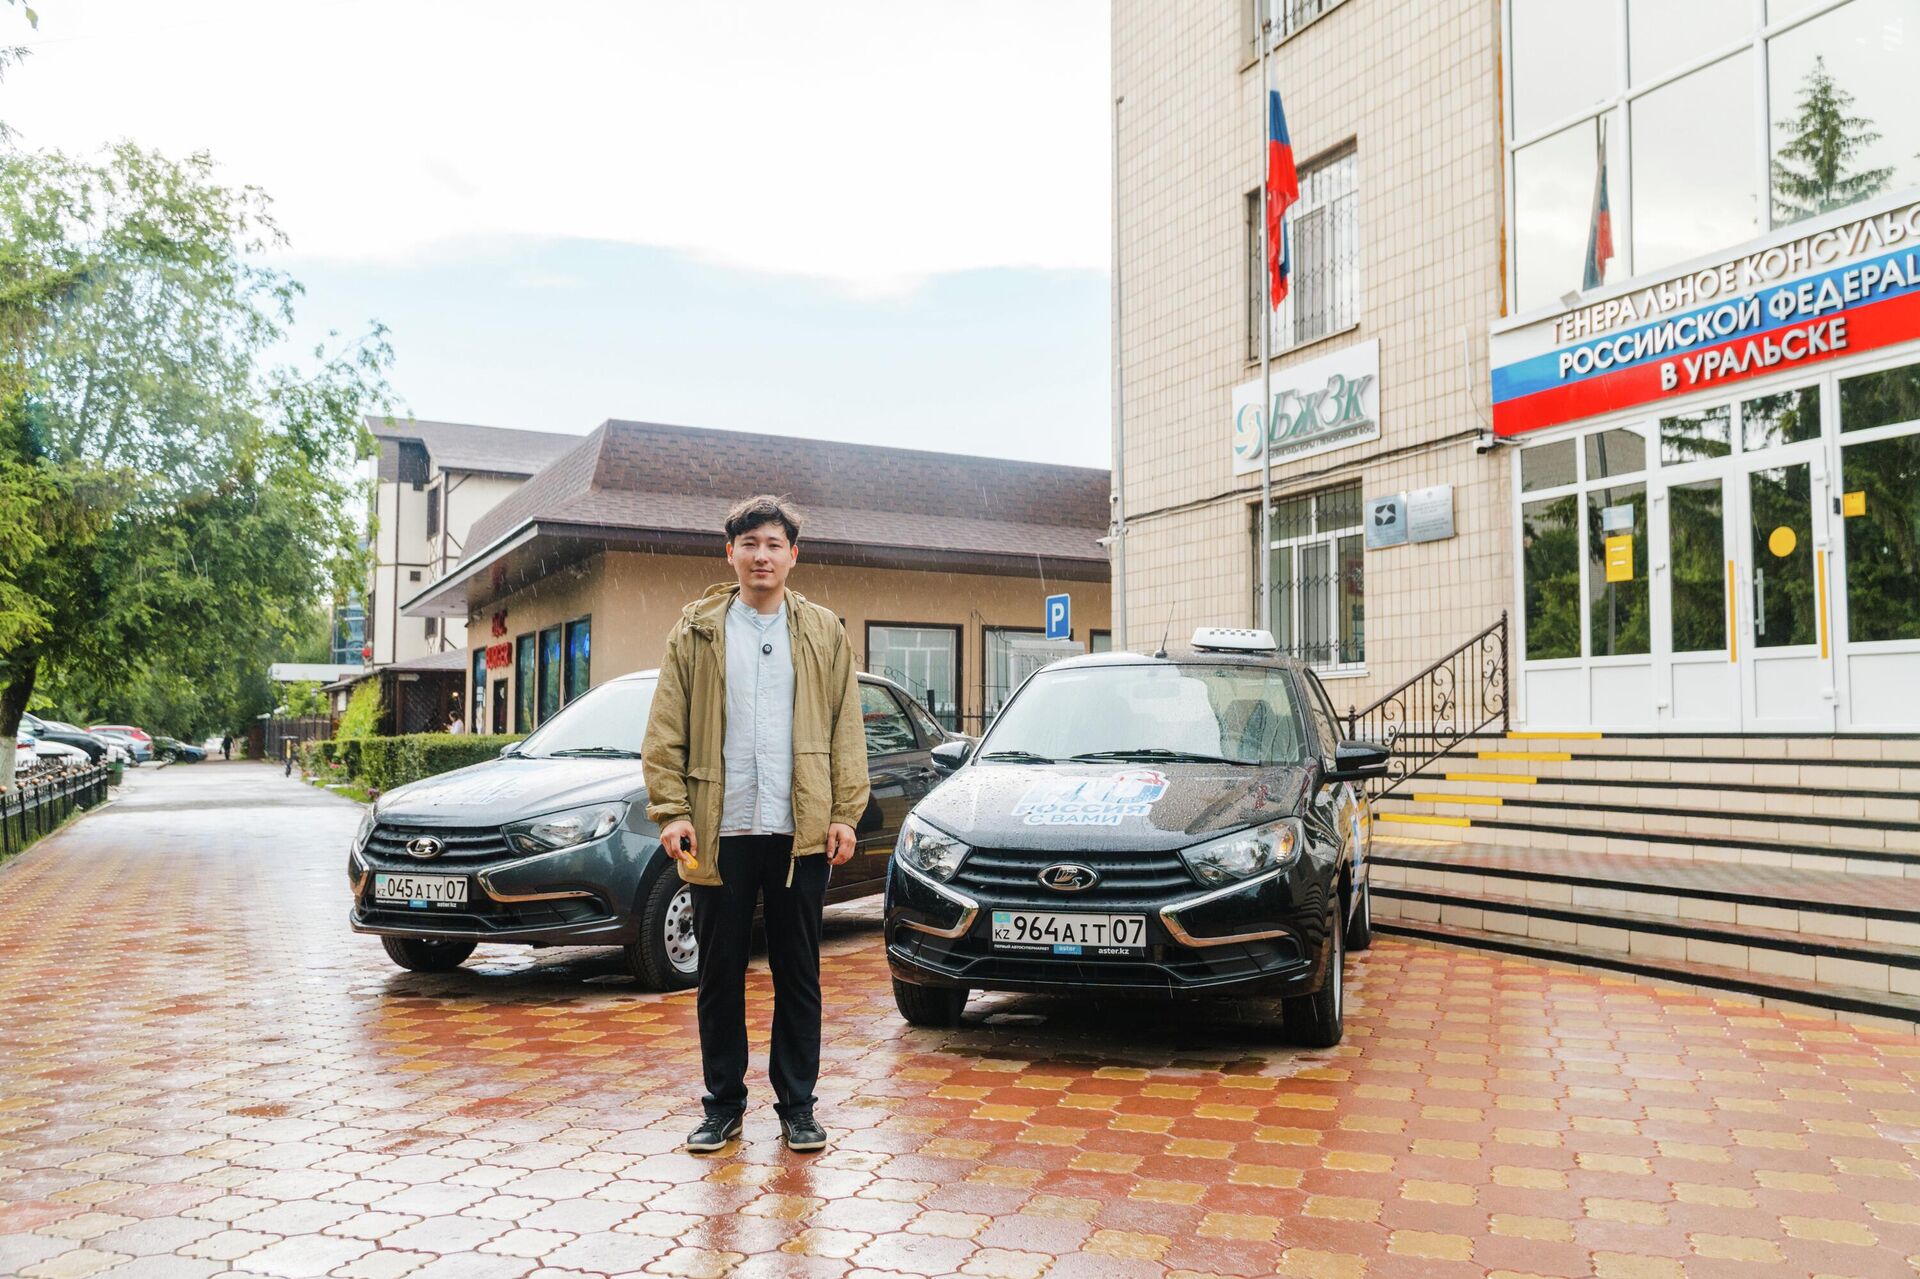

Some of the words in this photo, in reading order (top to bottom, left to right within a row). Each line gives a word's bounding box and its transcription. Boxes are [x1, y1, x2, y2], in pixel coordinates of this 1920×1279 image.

[1553, 262, 1738, 344] ГЕНЕРАЛЬНОЕ
[1661, 362, 1679, 392] В
[1683, 317, 1848, 385] УРАЛЬСКЕ
[1051, 602, 1065, 633] P
[1016, 803, 1147, 814] РОССИЯ
[1028, 815, 1044, 824] С
[1050, 814, 1118, 824] ВАМИ
[995, 929, 1011, 940] KZ
